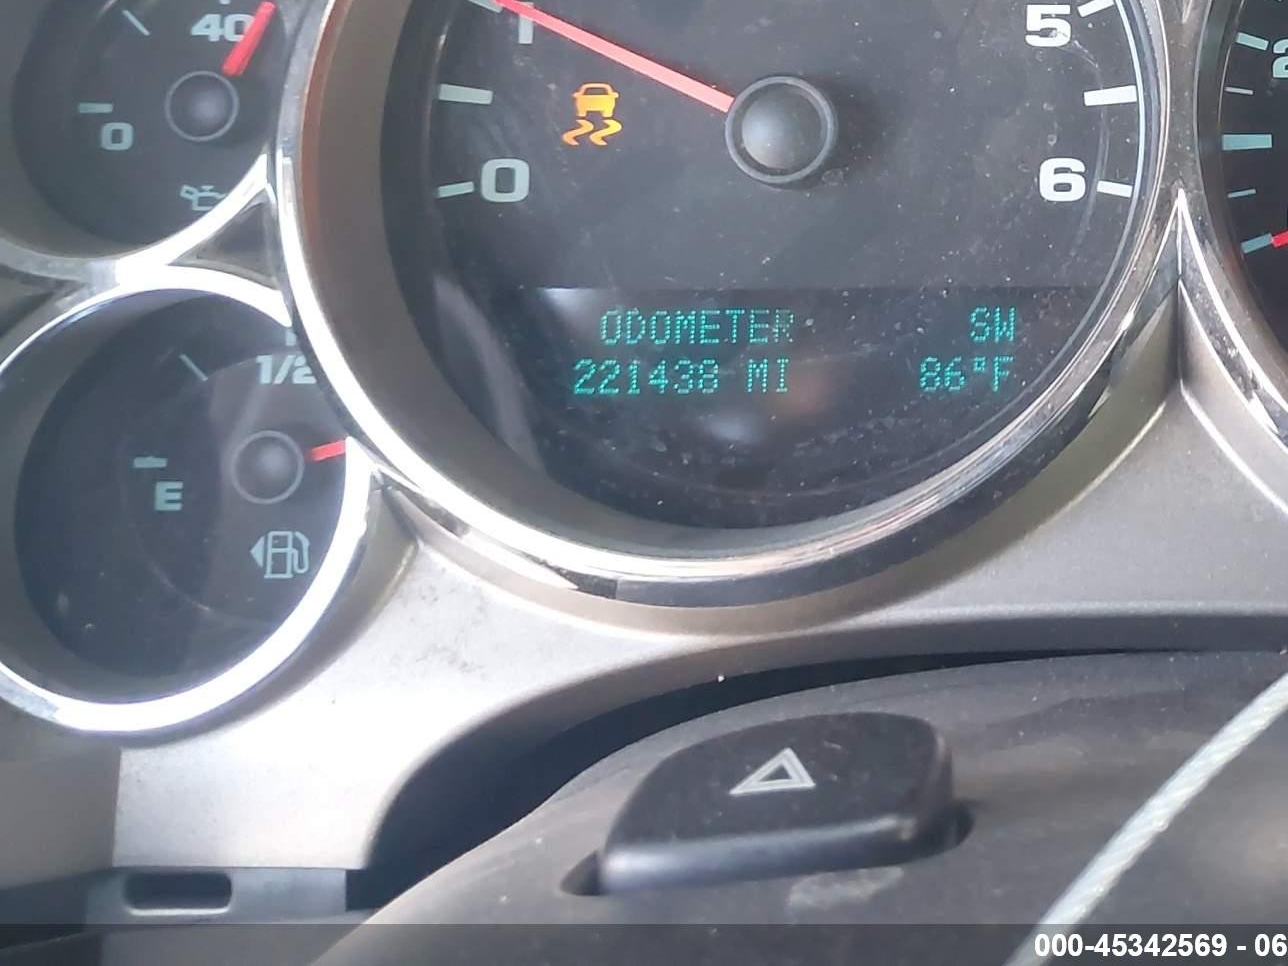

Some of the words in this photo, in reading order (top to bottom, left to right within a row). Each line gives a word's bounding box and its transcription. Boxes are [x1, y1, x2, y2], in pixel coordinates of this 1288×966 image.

[190, 13, 254, 42] 40
[1025, 4, 1071, 47] 5
[100, 122, 133, 150] 0
[481, 159, 530, 202] 0
[1039, 158, 1086, 202] 6
[600, 307, 795, 344] ODOMETER
[969, 307, 1016, 342] SW
[256, 354, 318, 385] 1/2
[573, 358, 719, 395] 221438
[746, 358, 789, 393] MI
[154, 481, 183, 511] E
